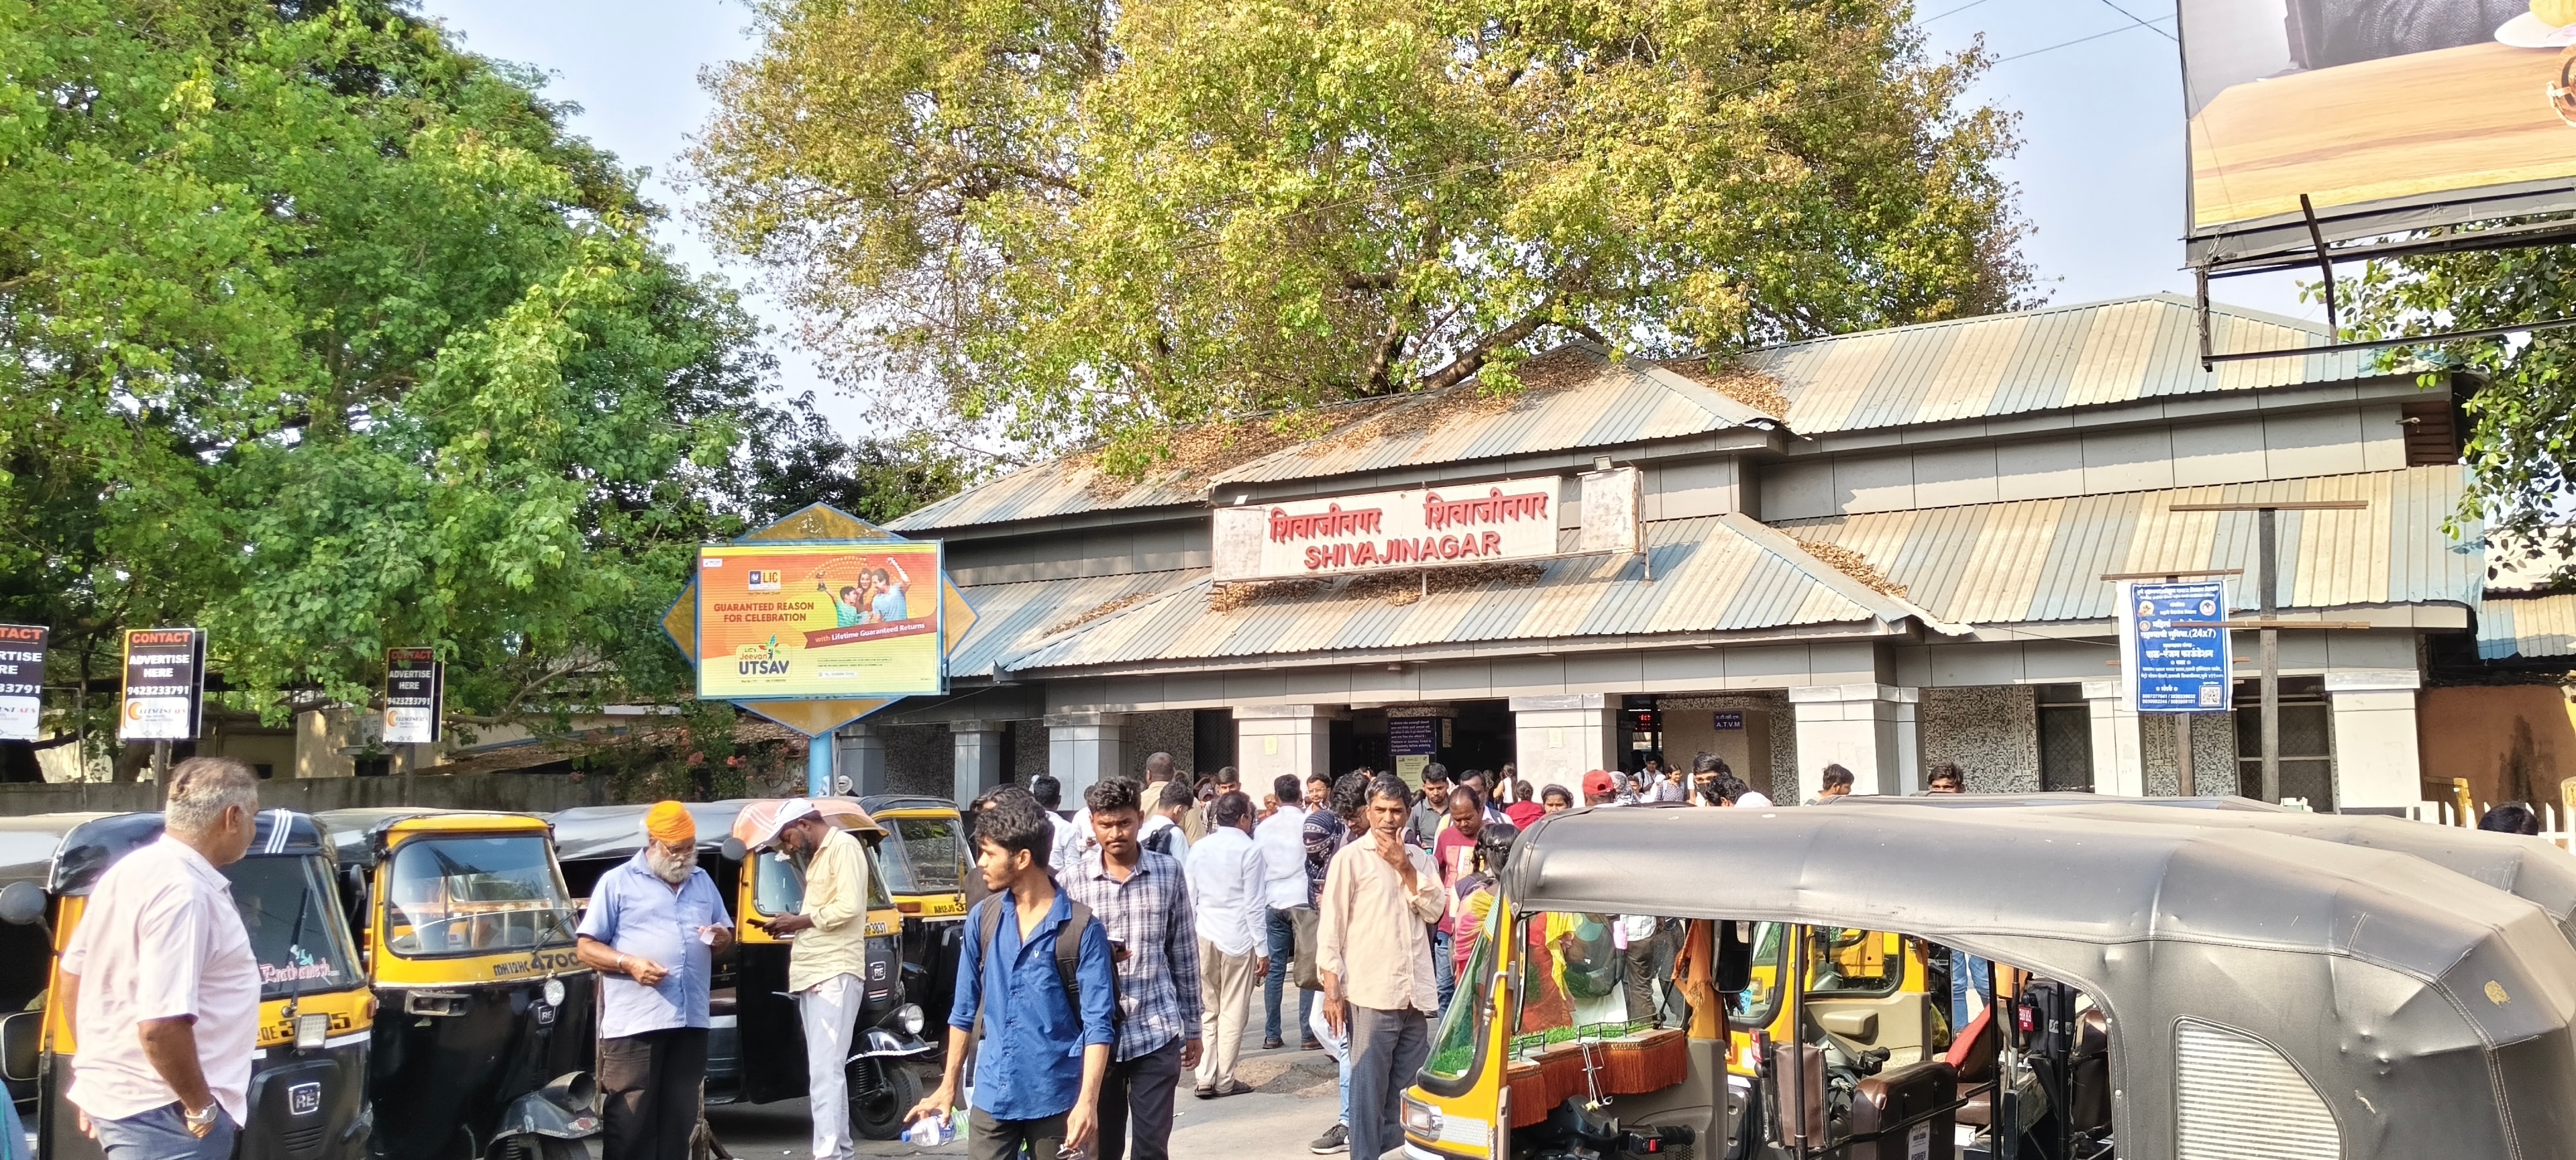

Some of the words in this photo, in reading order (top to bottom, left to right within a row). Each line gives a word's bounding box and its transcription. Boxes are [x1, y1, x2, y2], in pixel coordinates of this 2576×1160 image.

[1268, 502, 1383, 544] शिवाजीनगर
[1423, 486, 1549, 530] शिवाजीनगर
[1303, 531, 1501, 570] SHIVAJINAGAR
[763, 572, 778, 583] LIC
[713, 602, 774, 612] GUARANTEED
[777, 602, 814, 611] REASON
[724, 614, 743, 623] FOR
[745, 613, 806, 622] CELEBRATION
[0, 627, 44, 640] TACT
[131, 632, 191, 643] CONTACT
[815, 635, 830, 643] with
[831, 631, 859, 641] Lifetime
[860, 625, 899, 637] Guaranteed
[900, 623, 925, 631] Returns
[128, 654, 191, 665] ADVERTISE
[143, 668, 174, 678] HERE
[739, 660, 790, 675] UTSAV
[388, 670, 431, 678] ADVERTISE
[127, 685, 189, 696] 9423233791
[398, 681, 420, 690] HERE
[387, 697, 430, 705] 9423233791
[874, 967, 883, 977] RE
[541, 1010, 553, 1020] RE
[296, 1092, 315, 1109] RE
